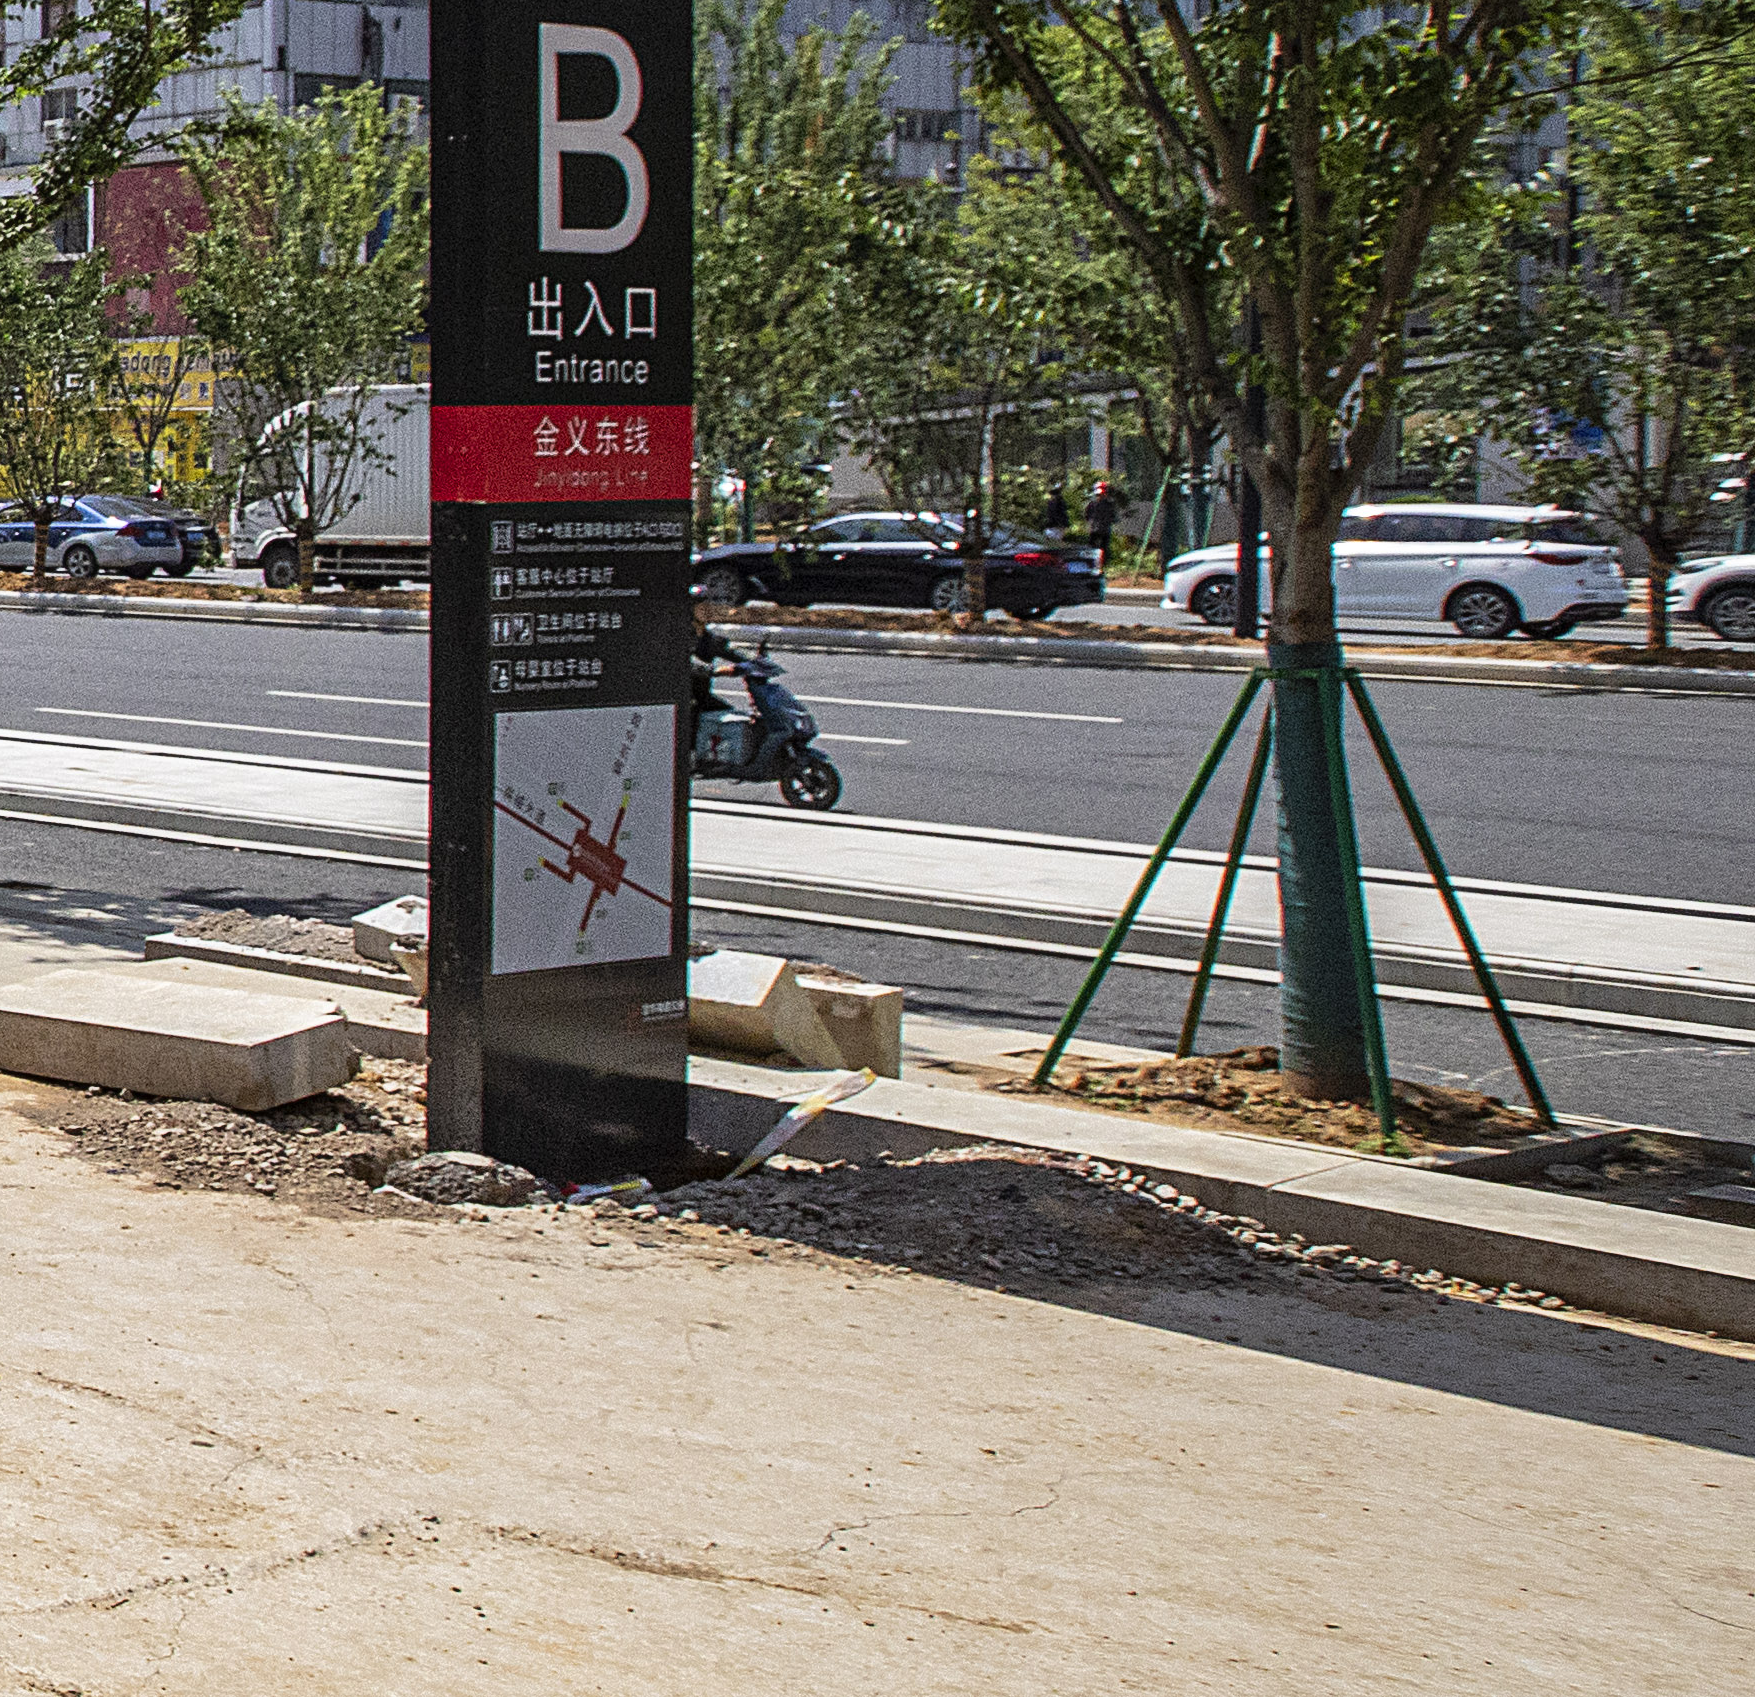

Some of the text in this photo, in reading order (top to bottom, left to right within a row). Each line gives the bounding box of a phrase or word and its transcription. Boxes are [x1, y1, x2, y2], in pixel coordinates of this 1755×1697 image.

[538, 21, 651, 254] B
[527, 275, 658, 341] 出入口
[534, 350, 651, 385] Entrance
[532, 415, 651, 459] 金义东线
